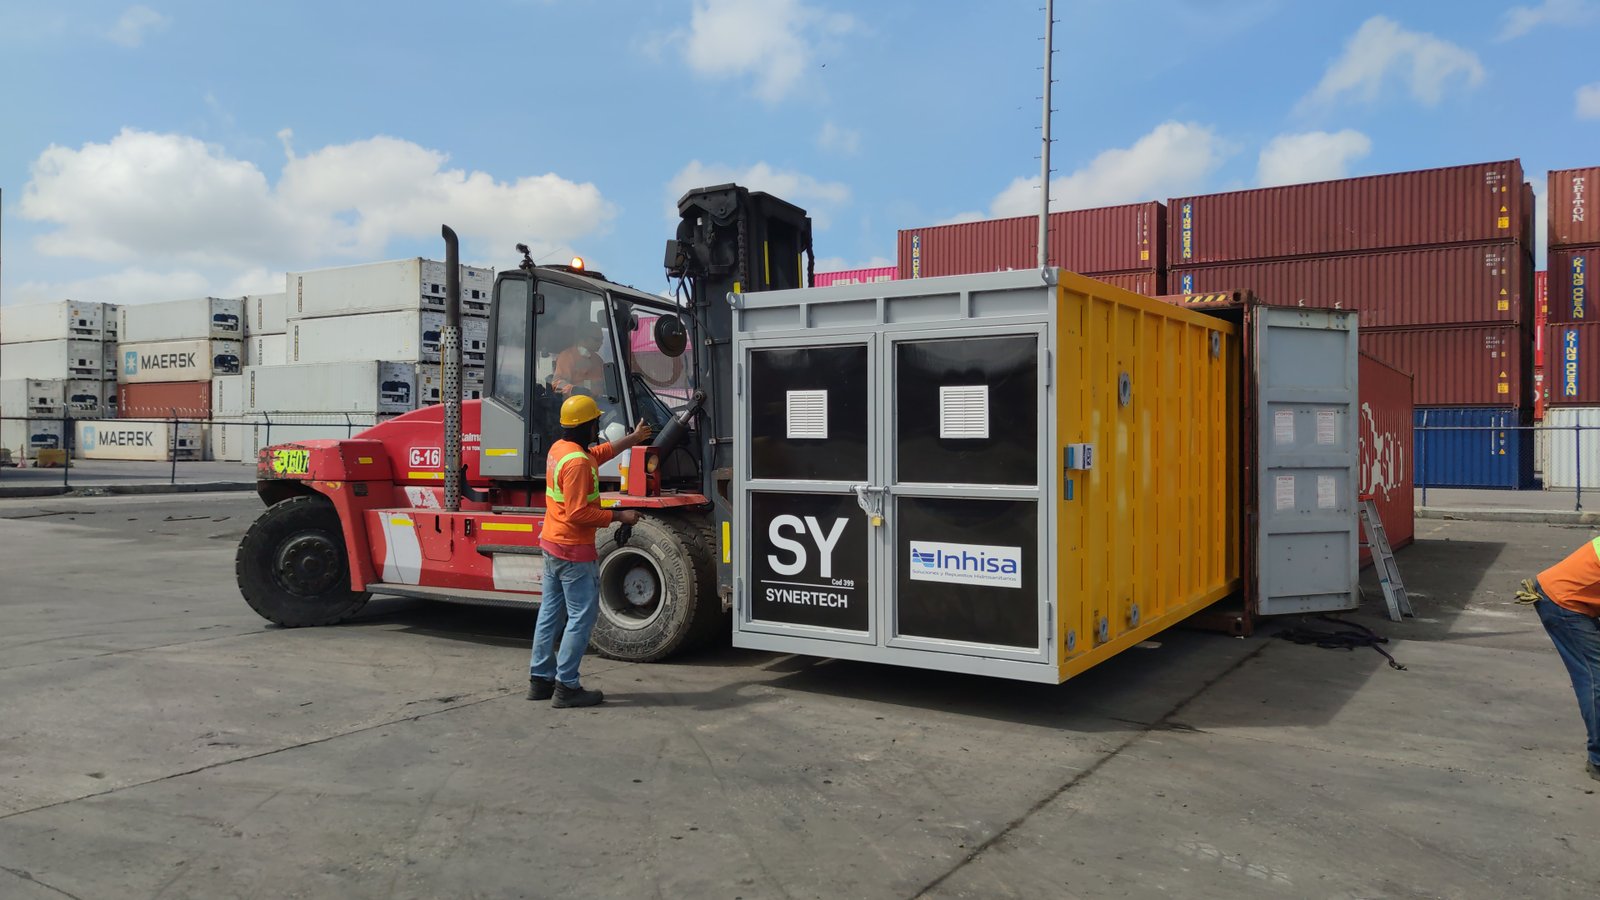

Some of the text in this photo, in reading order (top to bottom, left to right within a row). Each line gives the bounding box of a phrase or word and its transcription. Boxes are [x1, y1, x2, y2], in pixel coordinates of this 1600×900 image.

[1572, 177, 1585, 222] TRITON
[1183, 204, 1191, 259] KING OCEAN
[1183, 275, 1191, 295] KIN
[1573, 257, 1584, 318] KING OCEAN
[141, 352, 196, 370] MAERSK
[1566, 331, 1577, 395] KING OCEAN
[99, 431, 153, 447] MAERSK
[411, 449, 439, 465] G-16
[767, 514, 849, 578] SY
[937, 549, 1017, 574] Inhisa
[831, 578, 855, 587] Cod 399
[766, 588, 848, 608] SYNERTECH
